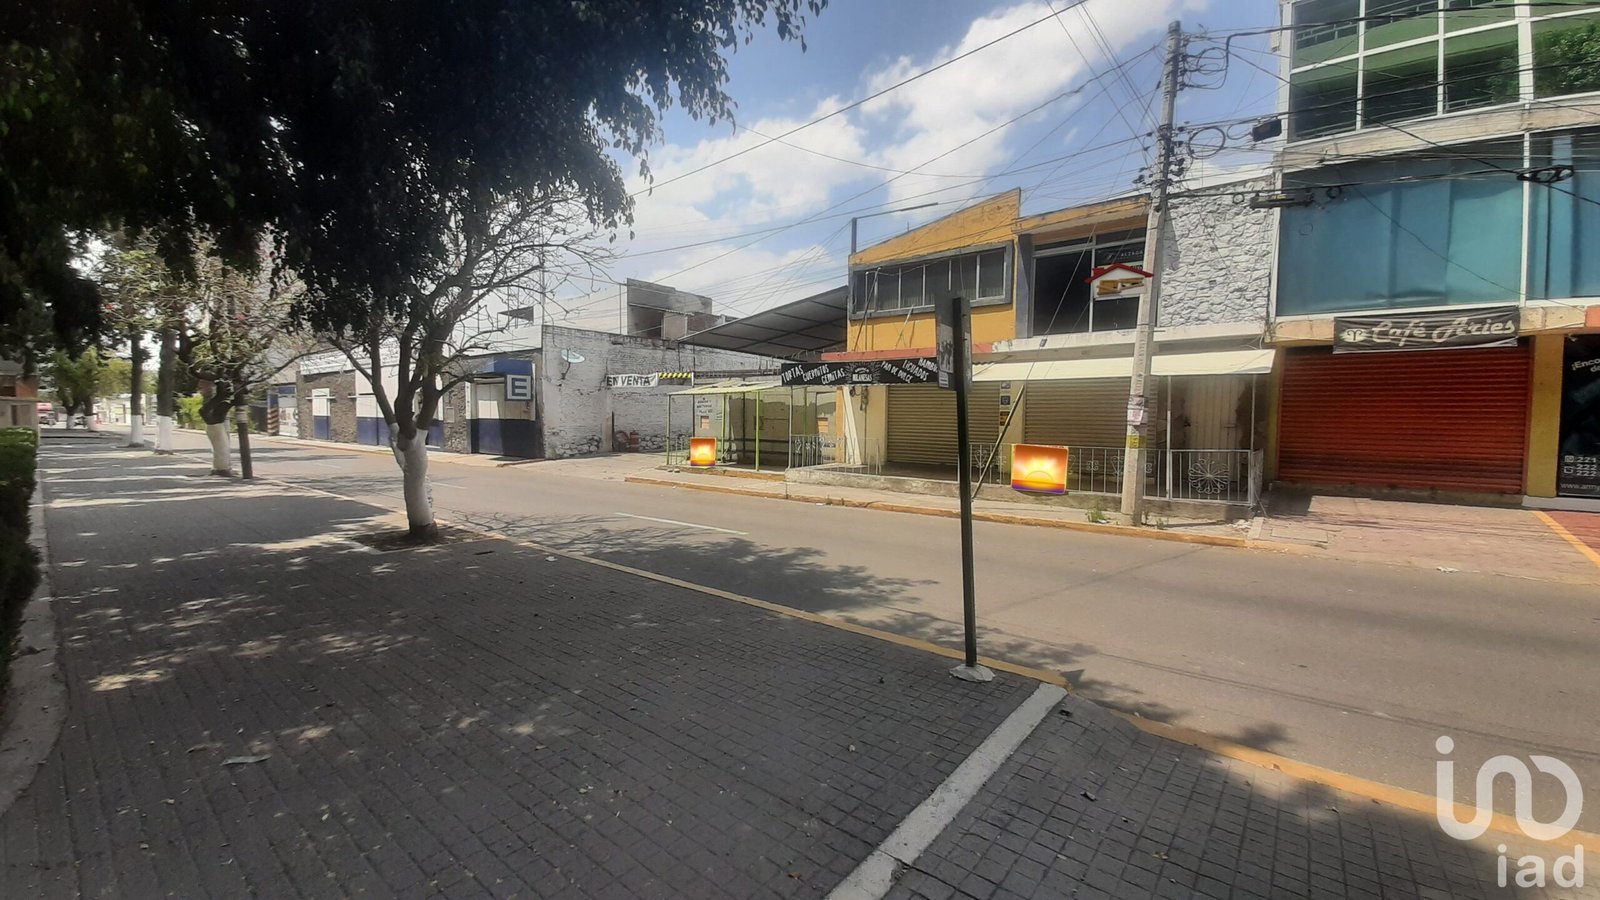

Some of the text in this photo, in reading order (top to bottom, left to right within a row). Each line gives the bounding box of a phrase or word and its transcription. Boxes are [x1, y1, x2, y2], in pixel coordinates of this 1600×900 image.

[1371, 316, 1515, 347] Café Aries
[782, 365, 804, 383] TORTAS
[890, 365, 897, 375] DE
[511, 377, 528, 397] E
[606, 376, 651, 387] EN VENTA
